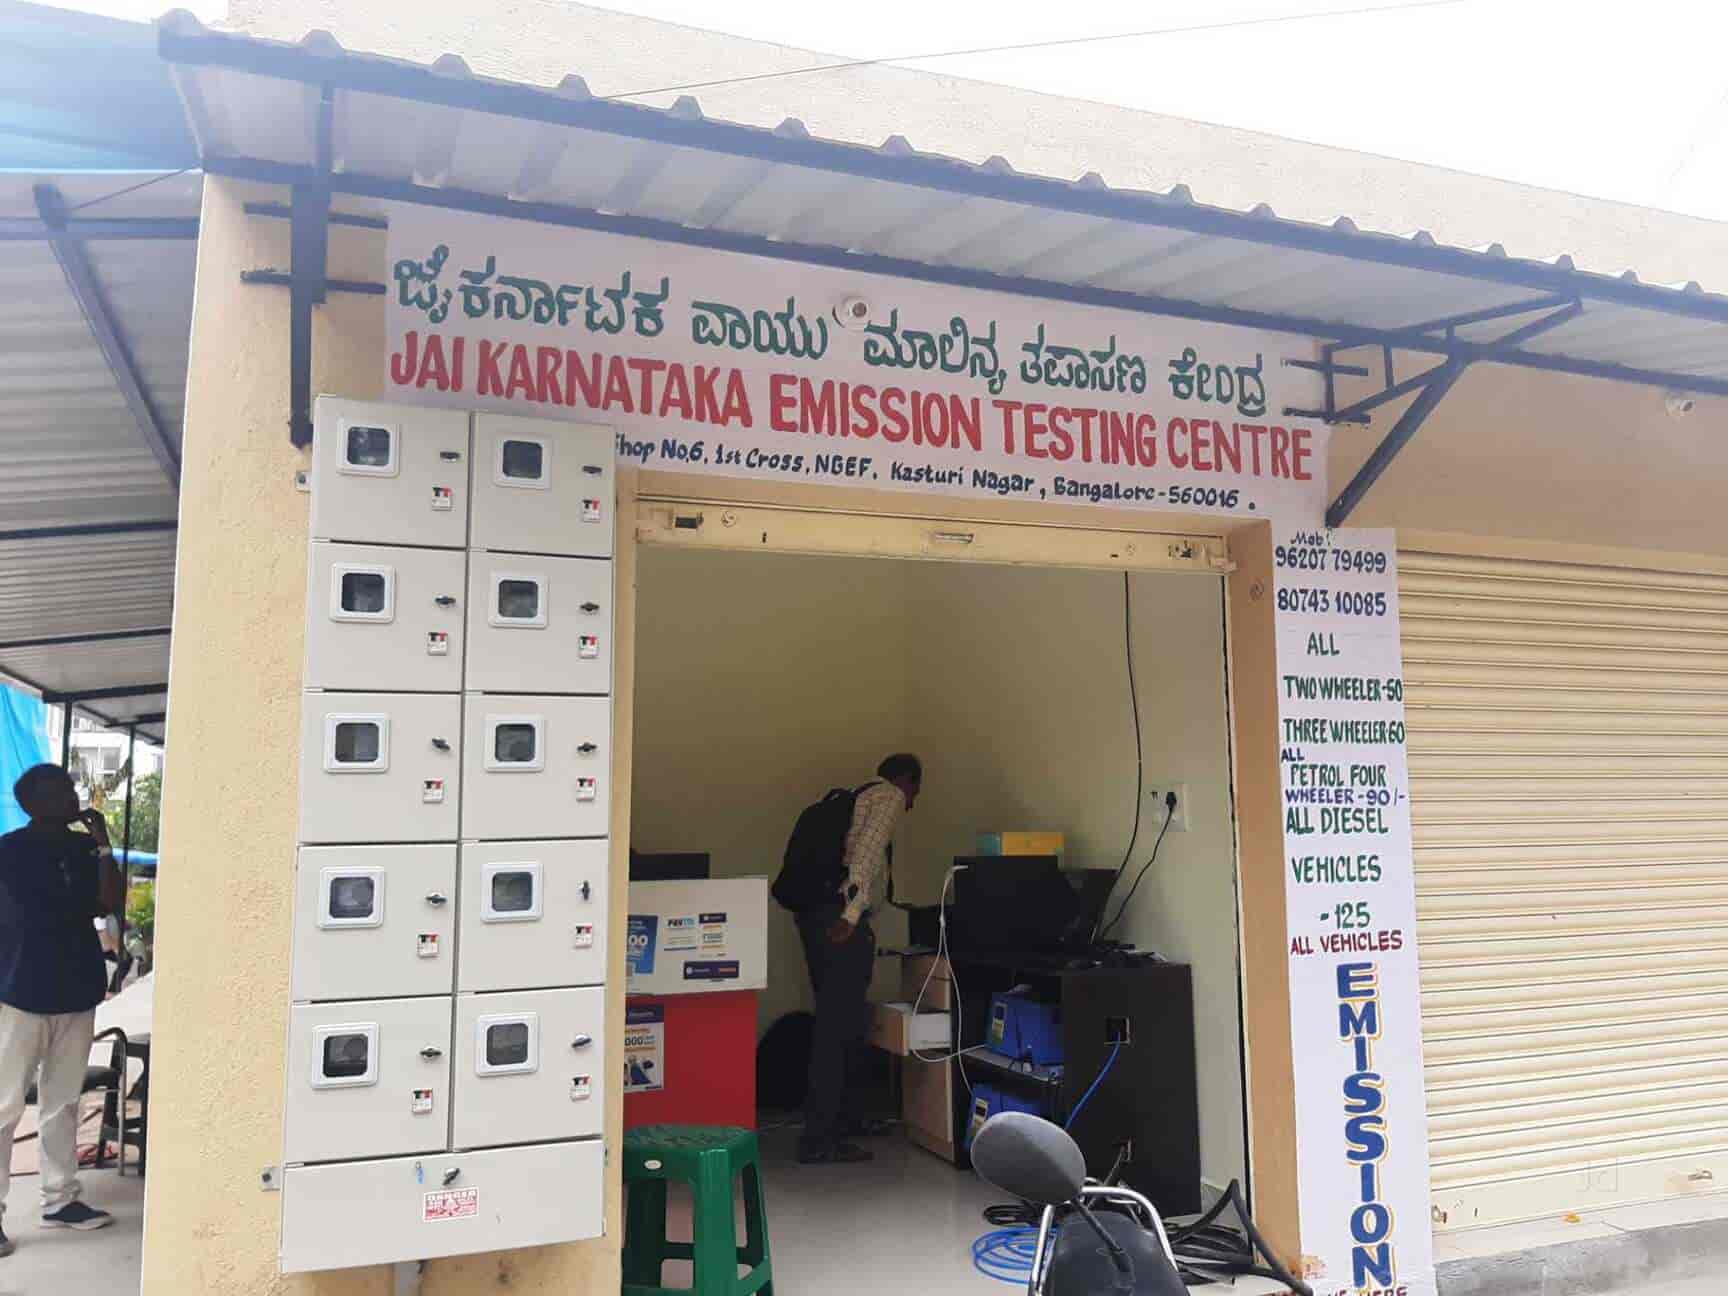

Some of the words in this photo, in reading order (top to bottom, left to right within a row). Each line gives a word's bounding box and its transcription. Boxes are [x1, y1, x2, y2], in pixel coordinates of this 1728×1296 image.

[690, 297, 828, 360] ವಾಯು
[863, 309, 1007, 394] ಮಾಲಿನ್ಯ
[1168, 347, 1267, 417] ಕೇಂದ್ರ
[391, 331, 465, 393] JAI
[477, 339, 752, 428] KARNATAKA
[769, 374, 982, 452] EMISSION
[991, 399, 1157, 468] TESTING
[1166, 415, 1313, 480] CENTRE
[715, 443, 741, 465] 1st
[890, 461, 964, 485] Kasturi
[1275, 546, 1327, 570] 96207
[1331, 549, 1387, 574] 79499
[1277, 588, 1330, 613] 80743
[1334, 591, 1387, 616] 10085
[1307, 632, 1340, 656] ALL
[1283, 675, 1317, 700] TWO
[1283, 718, 1328, 743] THREE
[1281, 747, 1305, 762] ALL
[1290, 764, 1344, 787] PETROL
[1350, 764, 1387, 787] FOUR
[1286, 807, 1315, 834] ALL
[1321, 807, 1389, 834] DIESEL
[1291, 855, 1382, 883] VEHICLES
[1290, 936, 1315, 955] ALL
[1320, 930, 1403, 952] VEHICLES
[1336, 962, 1396, 1289] EMISSION
